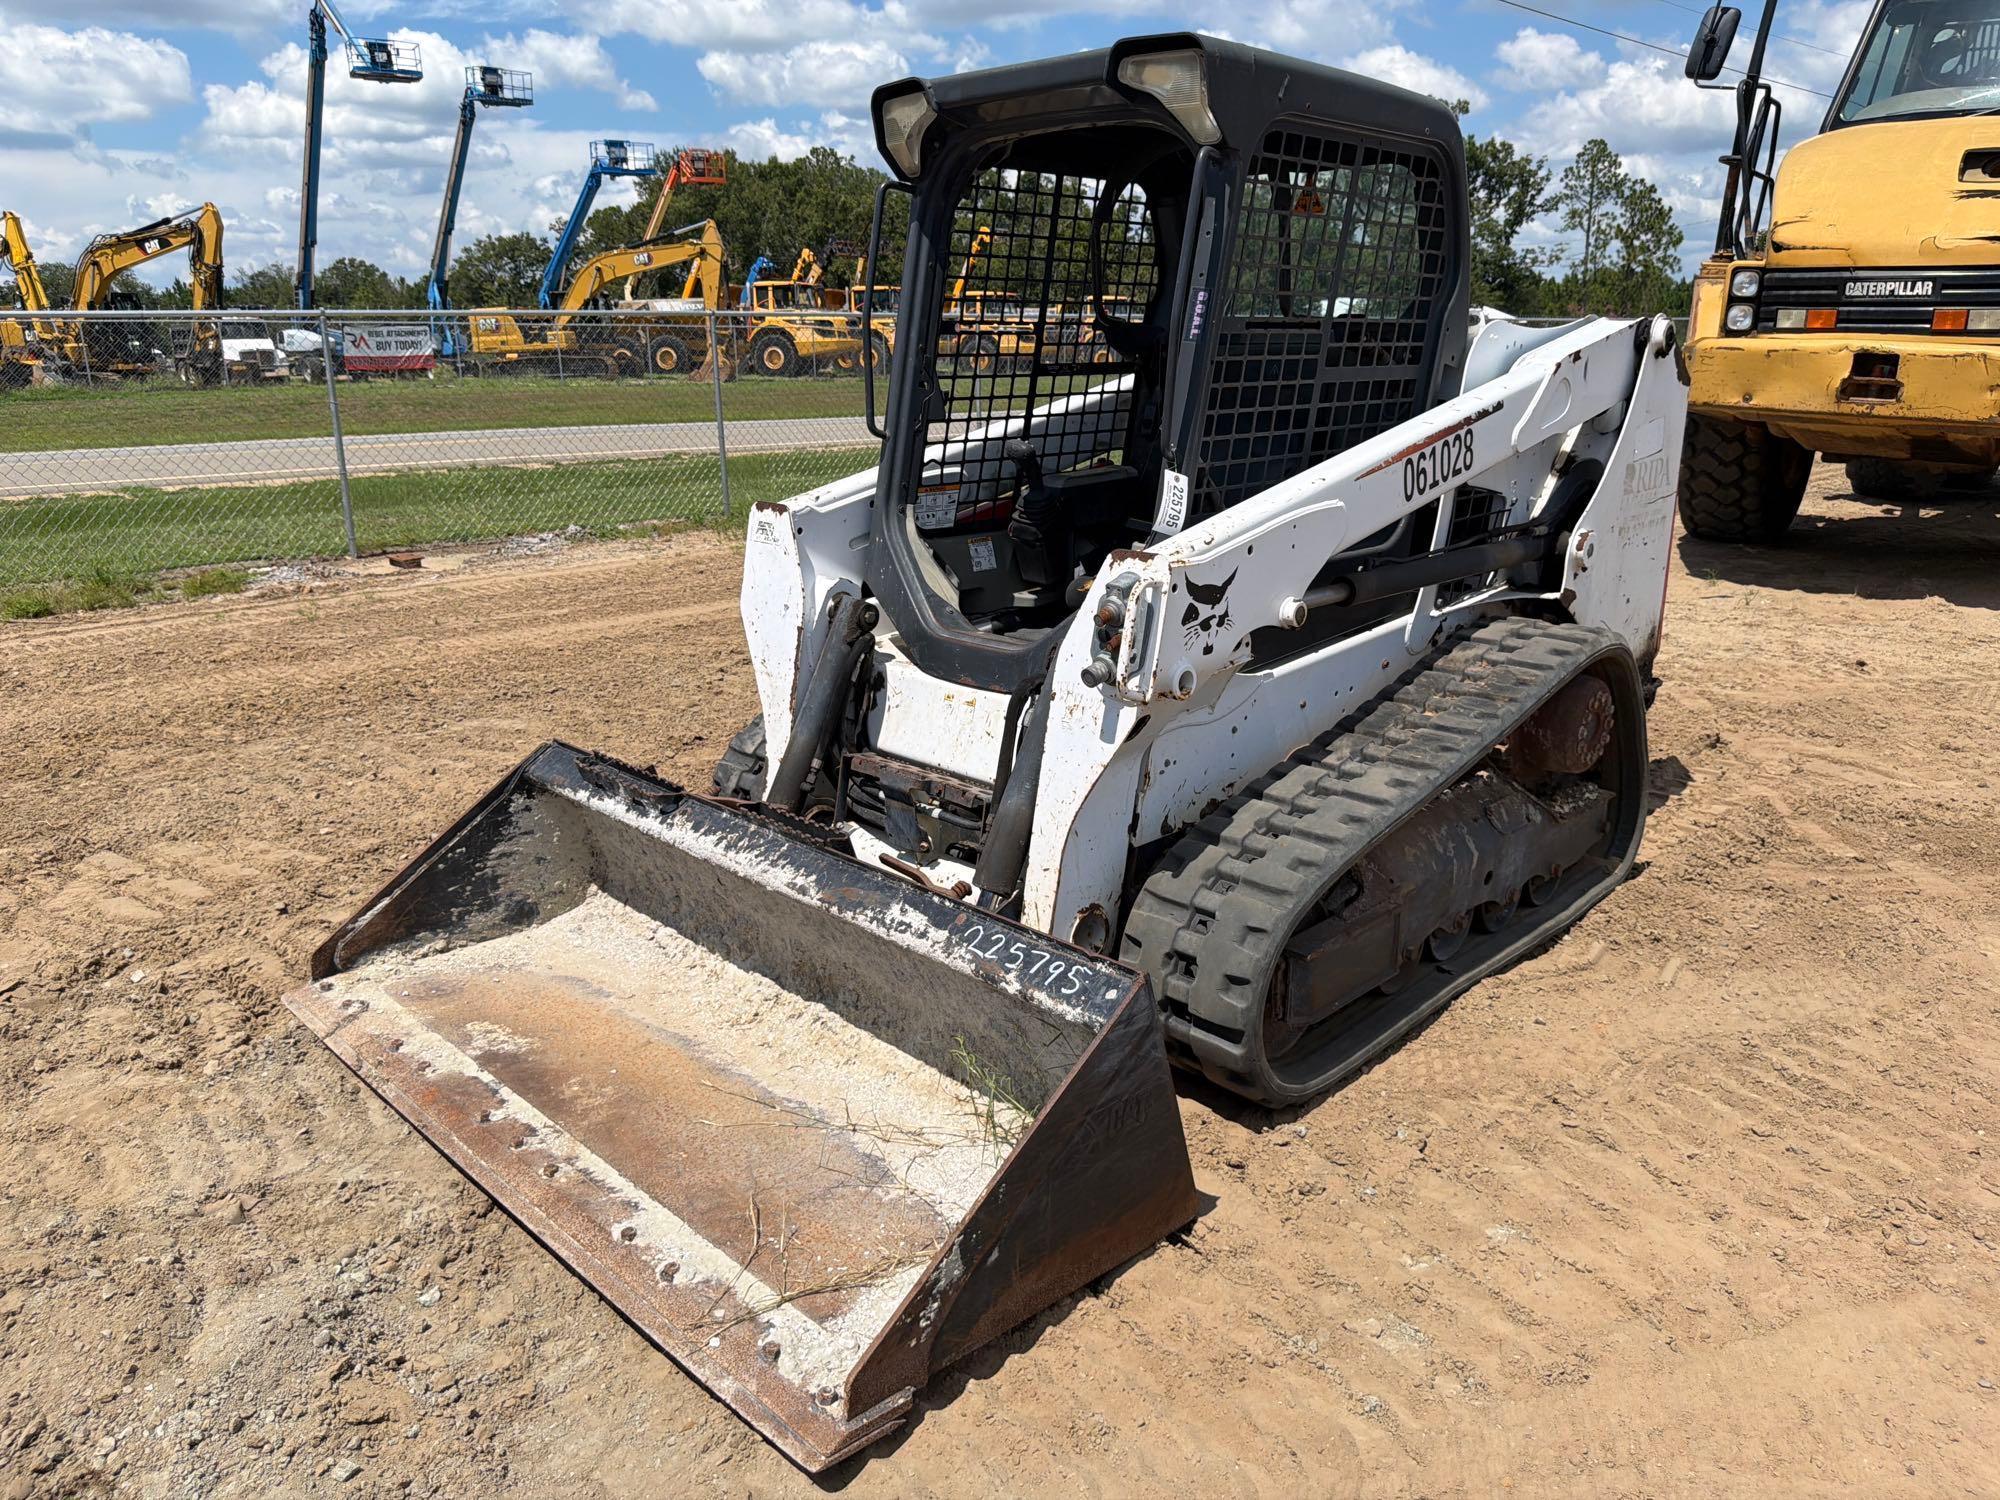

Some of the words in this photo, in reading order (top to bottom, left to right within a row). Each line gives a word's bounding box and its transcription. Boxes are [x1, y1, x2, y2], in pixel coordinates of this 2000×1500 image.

[144, 239, 160, 254] CAT
[634, 252, 650, 265] CAT
[1845, 281, 1933, 296] CATERPILLAR
[680, 303, 704, 311] VOLV
[479, 318, 497, 331] CAT
[376, 341, 392, 351] BUY
[1403, 428, 1474, 502] 061028
[1166, 485, 1184, 528] 225795
[964, 925, 1092, 994] 225795
